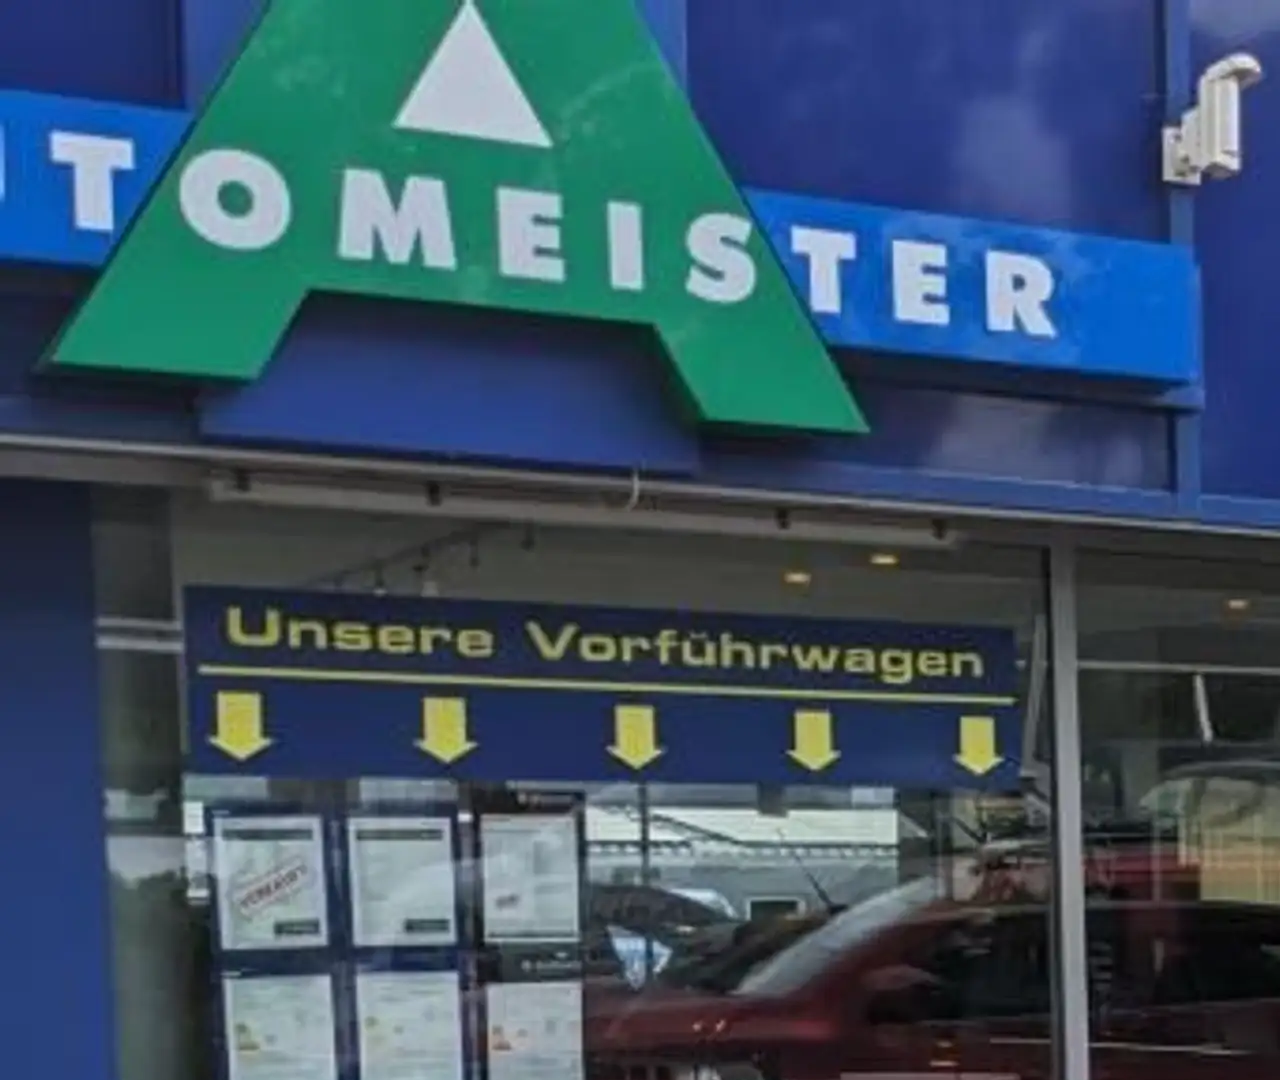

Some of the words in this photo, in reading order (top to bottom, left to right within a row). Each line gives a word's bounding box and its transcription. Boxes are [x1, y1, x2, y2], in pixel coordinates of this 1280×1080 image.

[0, 125, 1057, 339] TOMEISTER
[226, 606, 494, 660] Unsere
[527, 620, 984, 685] Vorführwagen
